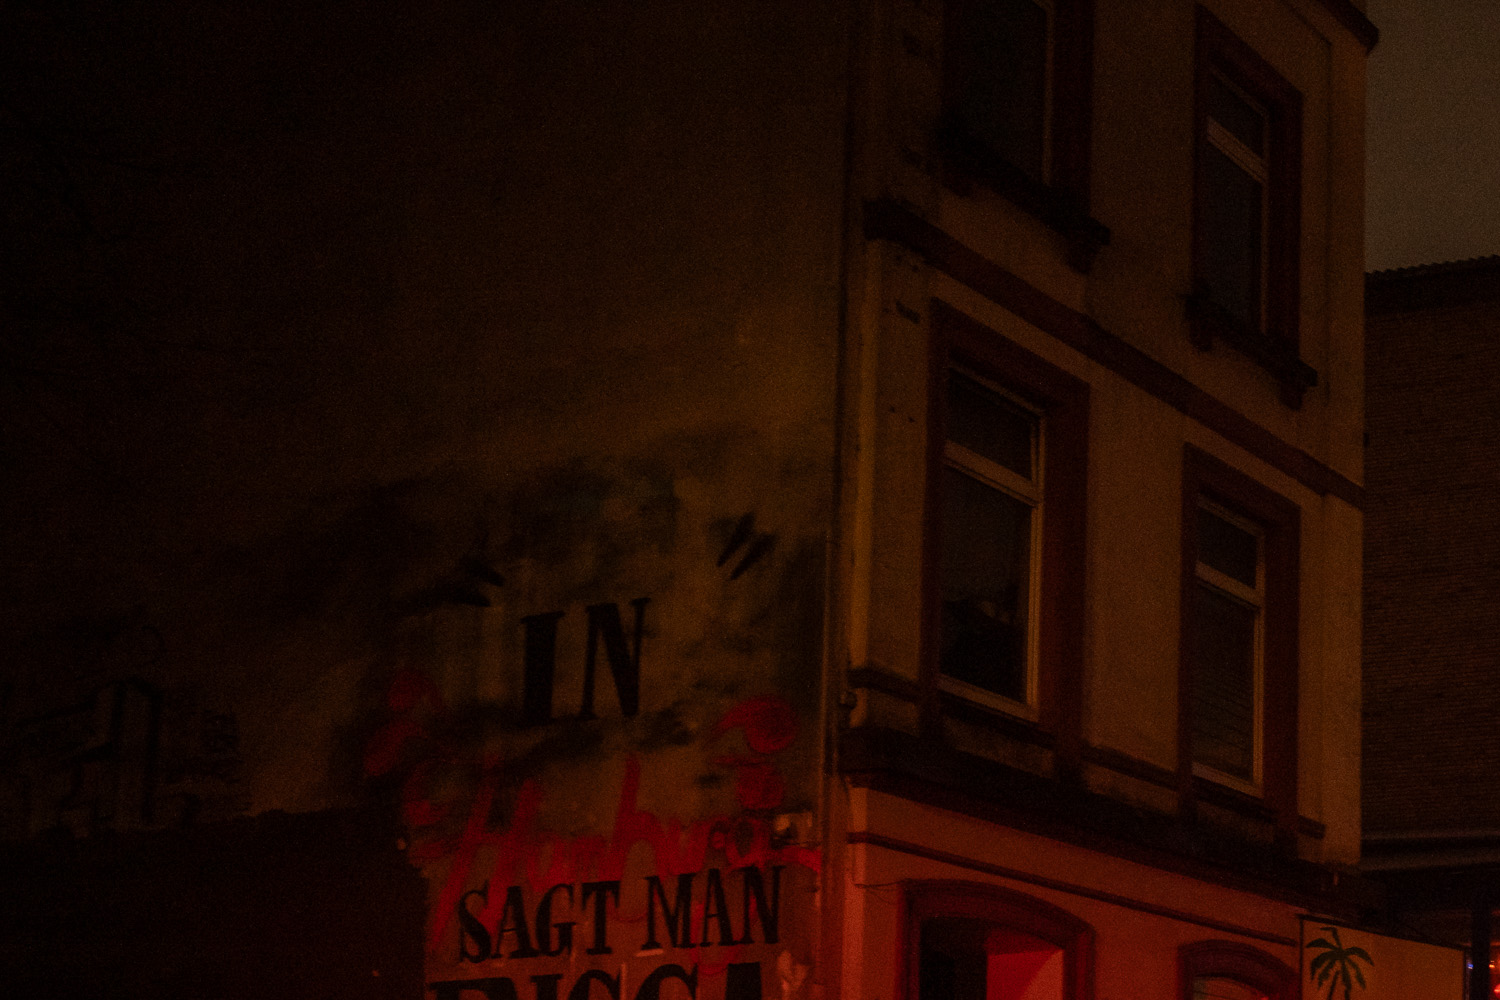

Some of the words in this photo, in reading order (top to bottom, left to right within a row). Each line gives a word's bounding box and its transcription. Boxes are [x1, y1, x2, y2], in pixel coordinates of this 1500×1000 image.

[521, 598, 650, 727] IN
[458, 880, 621, 964] SAGT
[645, 866, 785, 950] MAN
